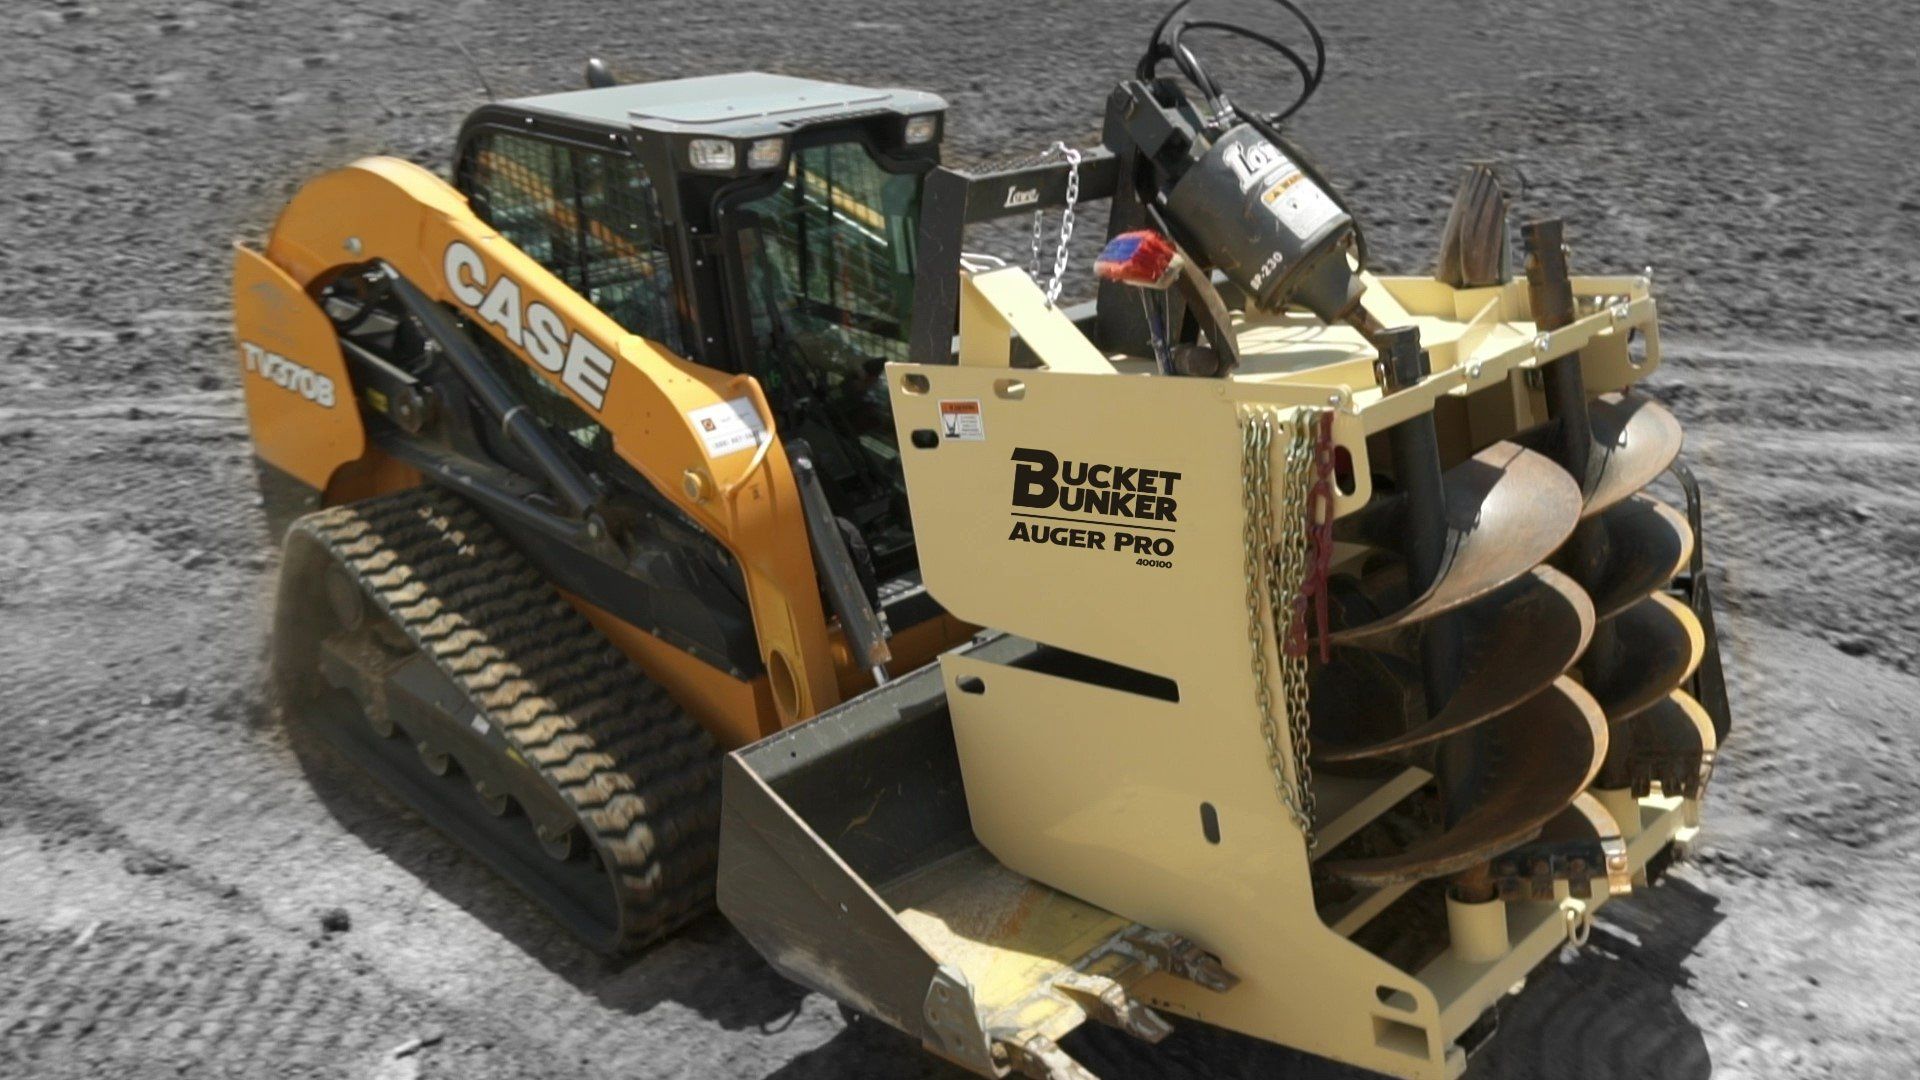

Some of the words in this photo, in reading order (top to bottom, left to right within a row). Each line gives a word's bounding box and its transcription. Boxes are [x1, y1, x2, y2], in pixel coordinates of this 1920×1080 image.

[443, 239, 616, 413] CASE
[240, 341, 336, 408] TV370B
[1011, 447, 1181, 508] BUCKET
[1008, 521, 1105, 550] AUGER
[1113, 531, 1174, 557] PRO
[1135, 558, 1172, 569] 400100
